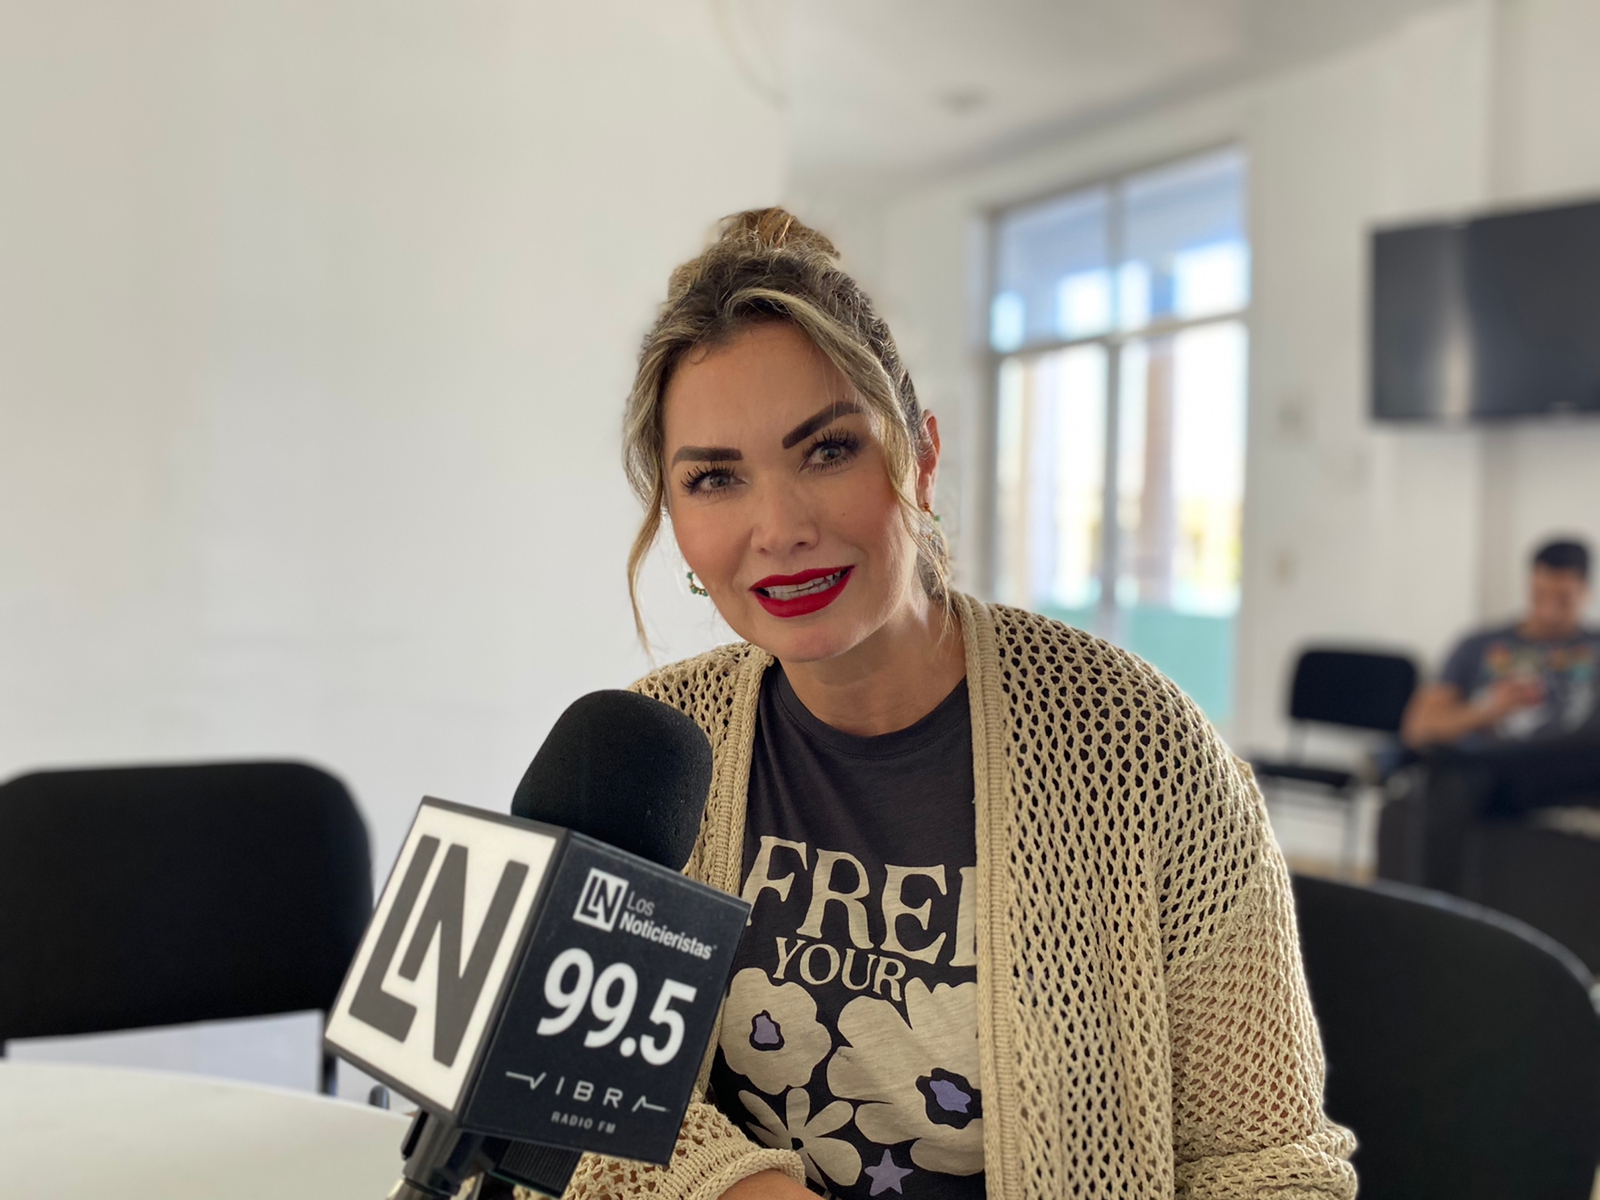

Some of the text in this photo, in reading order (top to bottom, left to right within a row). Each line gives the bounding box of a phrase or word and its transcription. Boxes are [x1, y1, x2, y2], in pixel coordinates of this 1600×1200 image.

[348, 834, 530, 1068] LN
[619, 911, 713, 960] Noticieristas
[772, 936, 906, 1001] YOUR
[536, 948, 697, 1066] 99.5
[505, 1071, 669, 1112] VIBRA
[551, 1111, 616, 1134] RADIO FM
